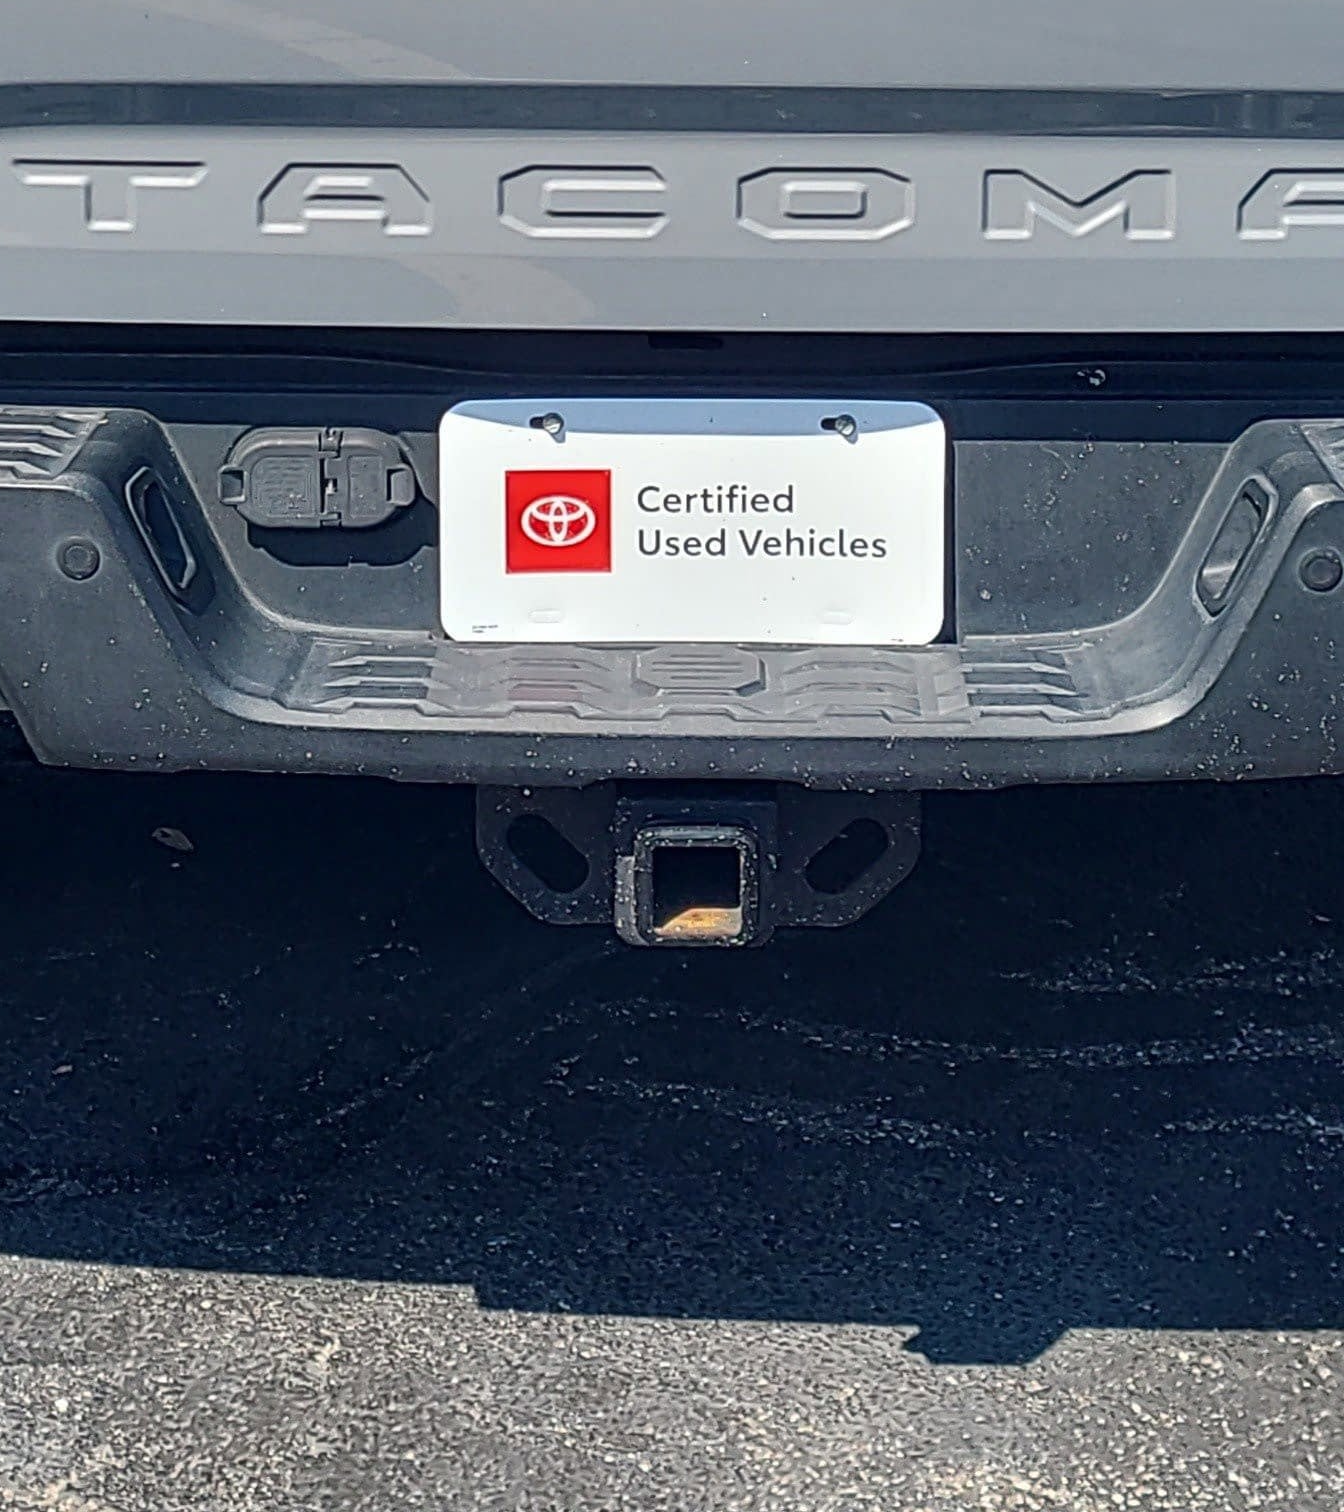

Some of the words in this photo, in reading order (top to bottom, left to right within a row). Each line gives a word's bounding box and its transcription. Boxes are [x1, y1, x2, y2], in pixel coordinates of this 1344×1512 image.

[636, 484, 796, 514] Certified
[637, 528, 728, 558] Used
[738, 528, 889, 559] Vehicles
